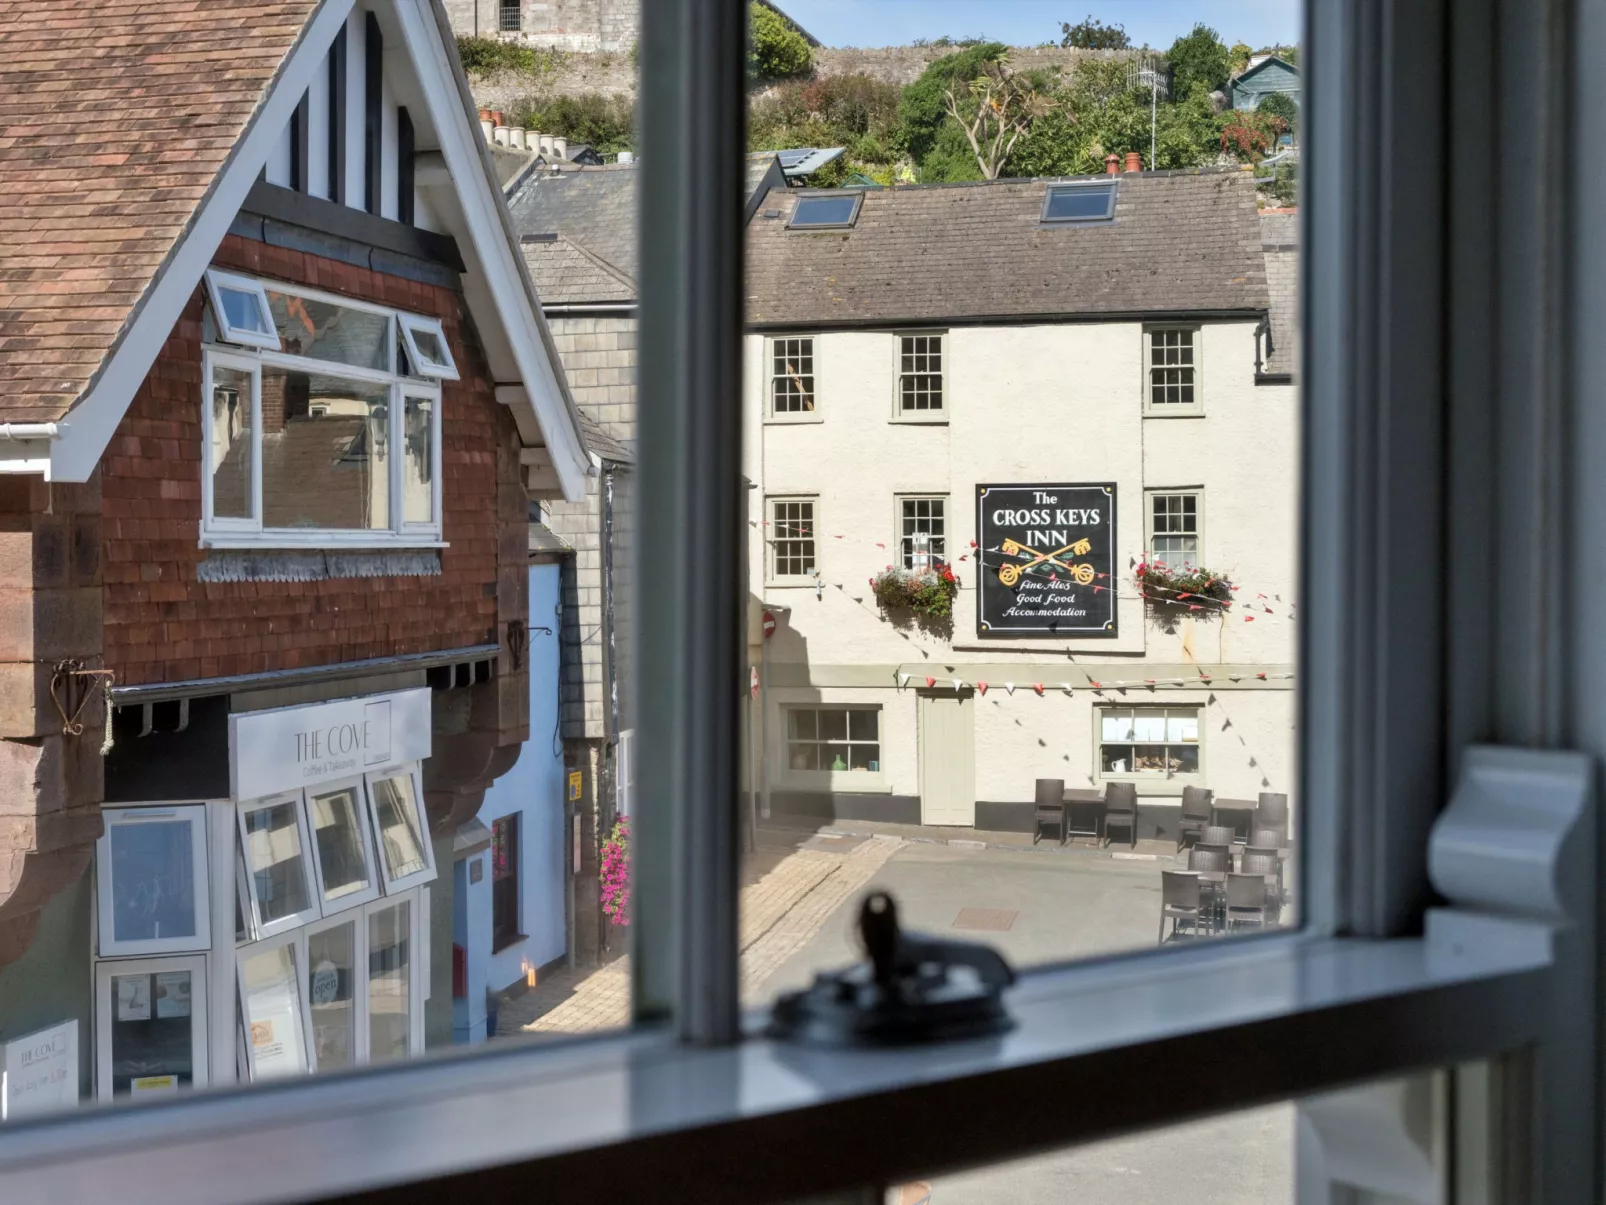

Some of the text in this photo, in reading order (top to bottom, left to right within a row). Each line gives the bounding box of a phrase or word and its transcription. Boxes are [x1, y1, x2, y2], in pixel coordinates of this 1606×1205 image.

[1033, 492, 1058, 504] The
[993, 509, 1100, 526] CROSS KEYS
[1026, 530, 1068, 546] INN
[1017, 580, 1071, 591] Fine Ales
[1016, 593, 1076, 606] Good Food
[294, 720, 371, 763] THE COVE
[303, 765, 322, 778] Coffee
[328, 758, 356, 772] Takeaway
